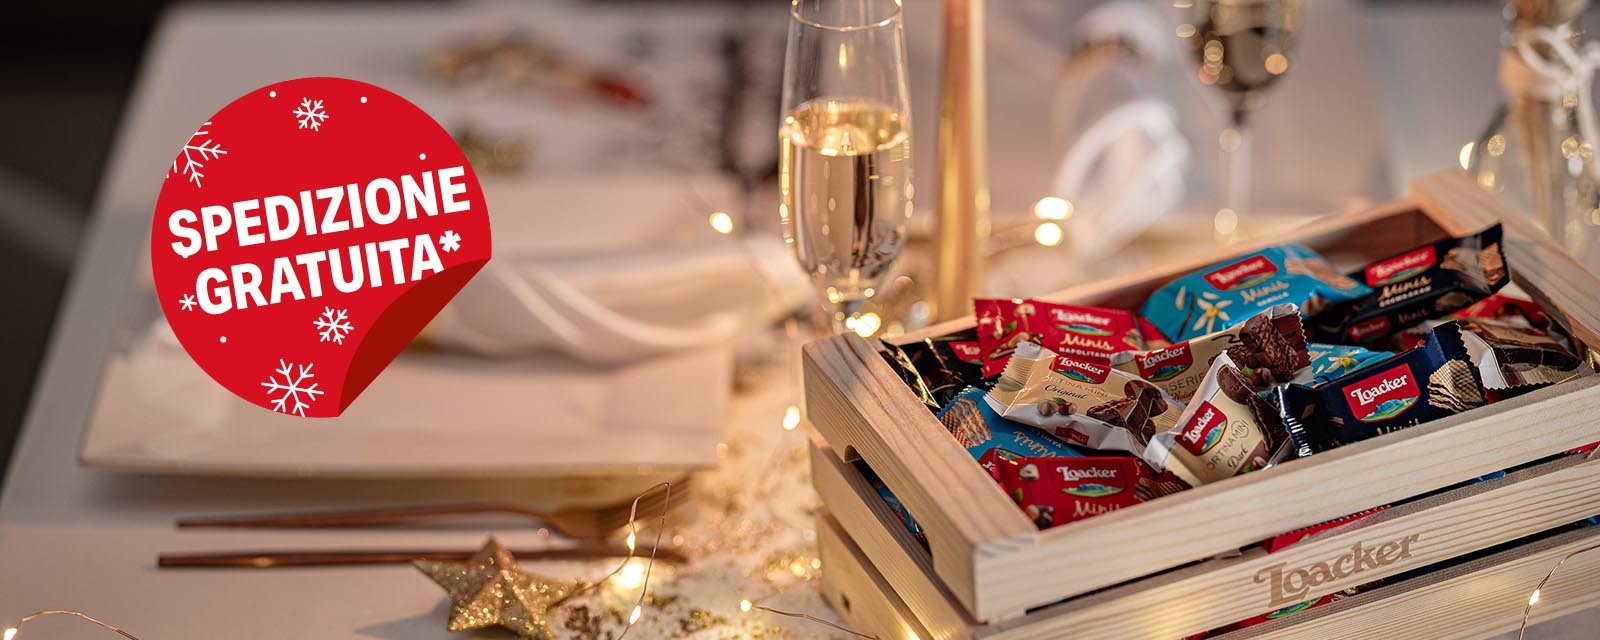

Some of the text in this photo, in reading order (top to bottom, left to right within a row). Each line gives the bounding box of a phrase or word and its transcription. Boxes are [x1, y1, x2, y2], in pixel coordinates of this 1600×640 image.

[1051, 308, 1111, 326] Loacker
[1060, 333, 1115, 351] Minis
[1059, 346, 1111, 359] NAPOLITANE
[1139, 346, 1186, 370] Loacker
[1058, 356, 1105, 375] Loacker
[1044, 384, 1088, 399] Original
[1351, 374, 1408, 406] Loacker
[1182, 407, 1216, 445] Loacker
[1227, 443, 1249, 470] Dark
[1056, 466, 1118, 481] Loacker
[1253, 533, 1420, 608] Loacker
